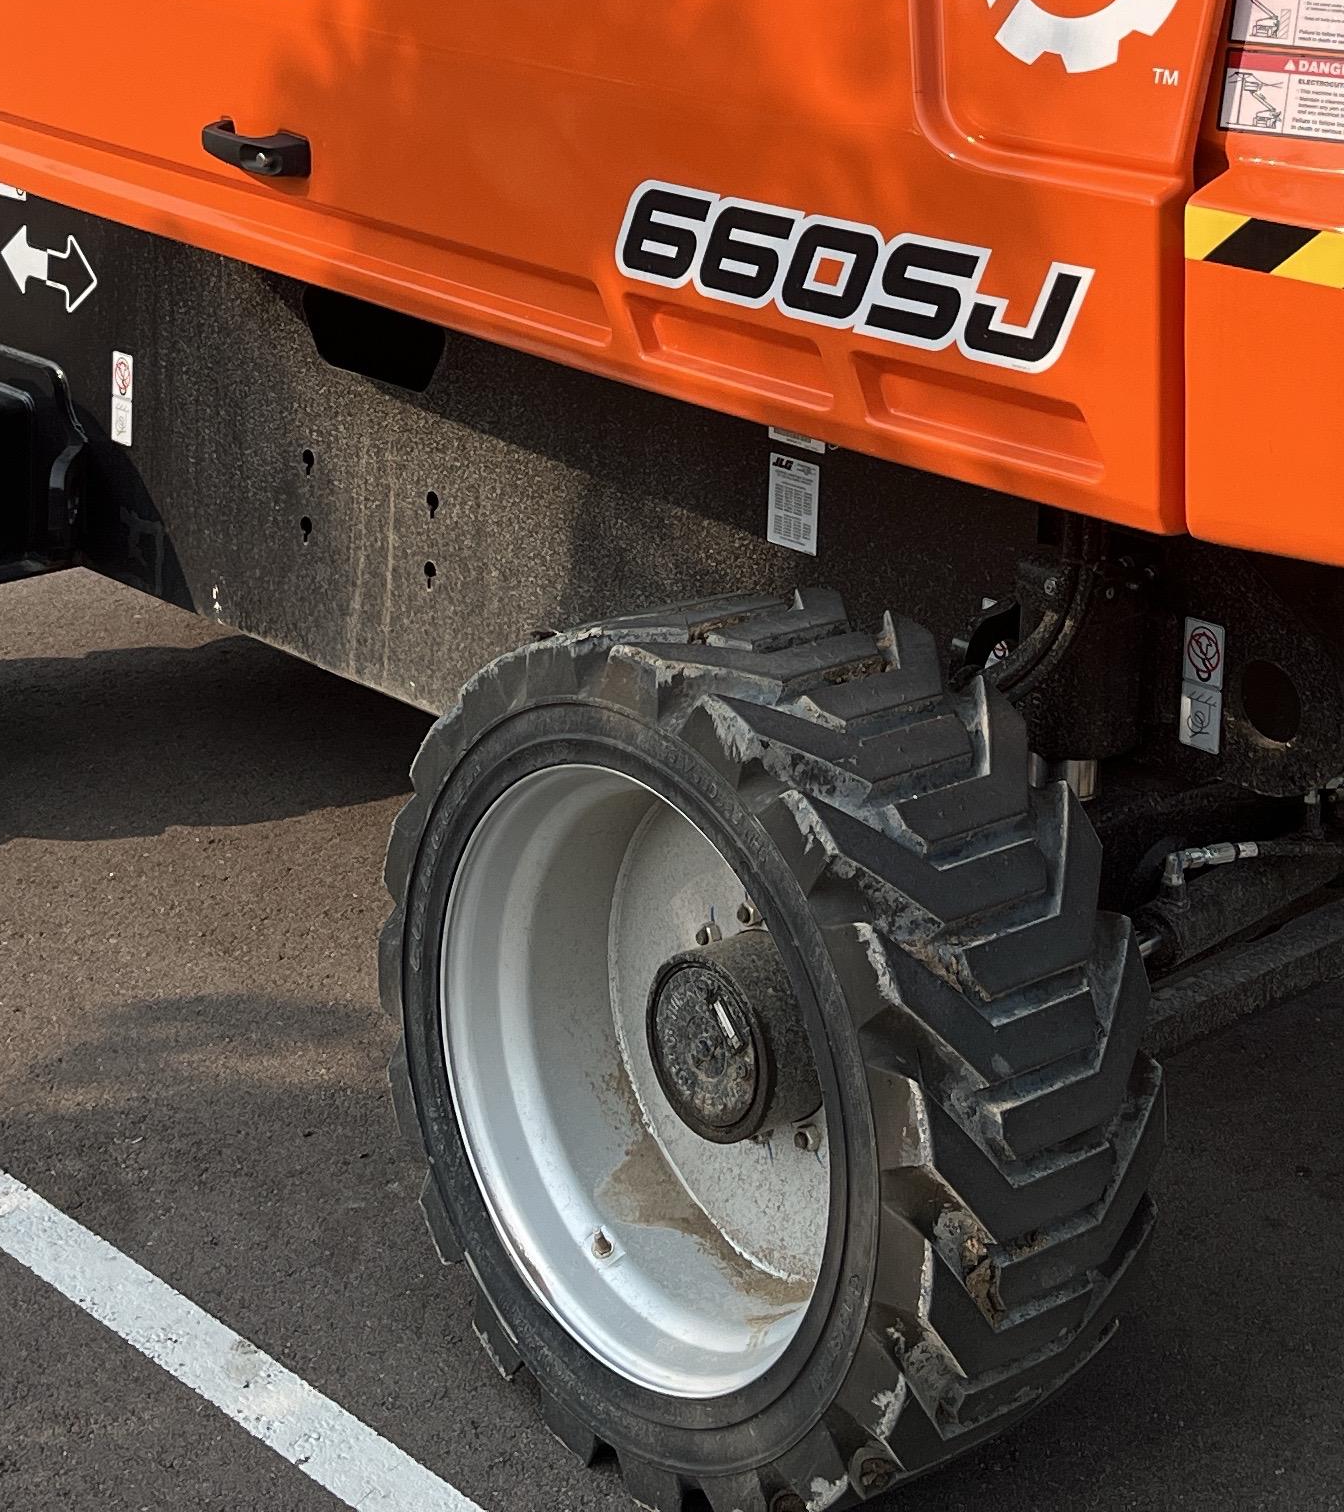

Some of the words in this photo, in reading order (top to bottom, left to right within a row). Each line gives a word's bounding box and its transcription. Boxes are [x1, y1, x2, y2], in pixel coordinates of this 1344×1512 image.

[1151, 67, 1179, 87] TM
[618, 183, 1089, 369] 660SJ
[772, 457, 794, 471] JLG
